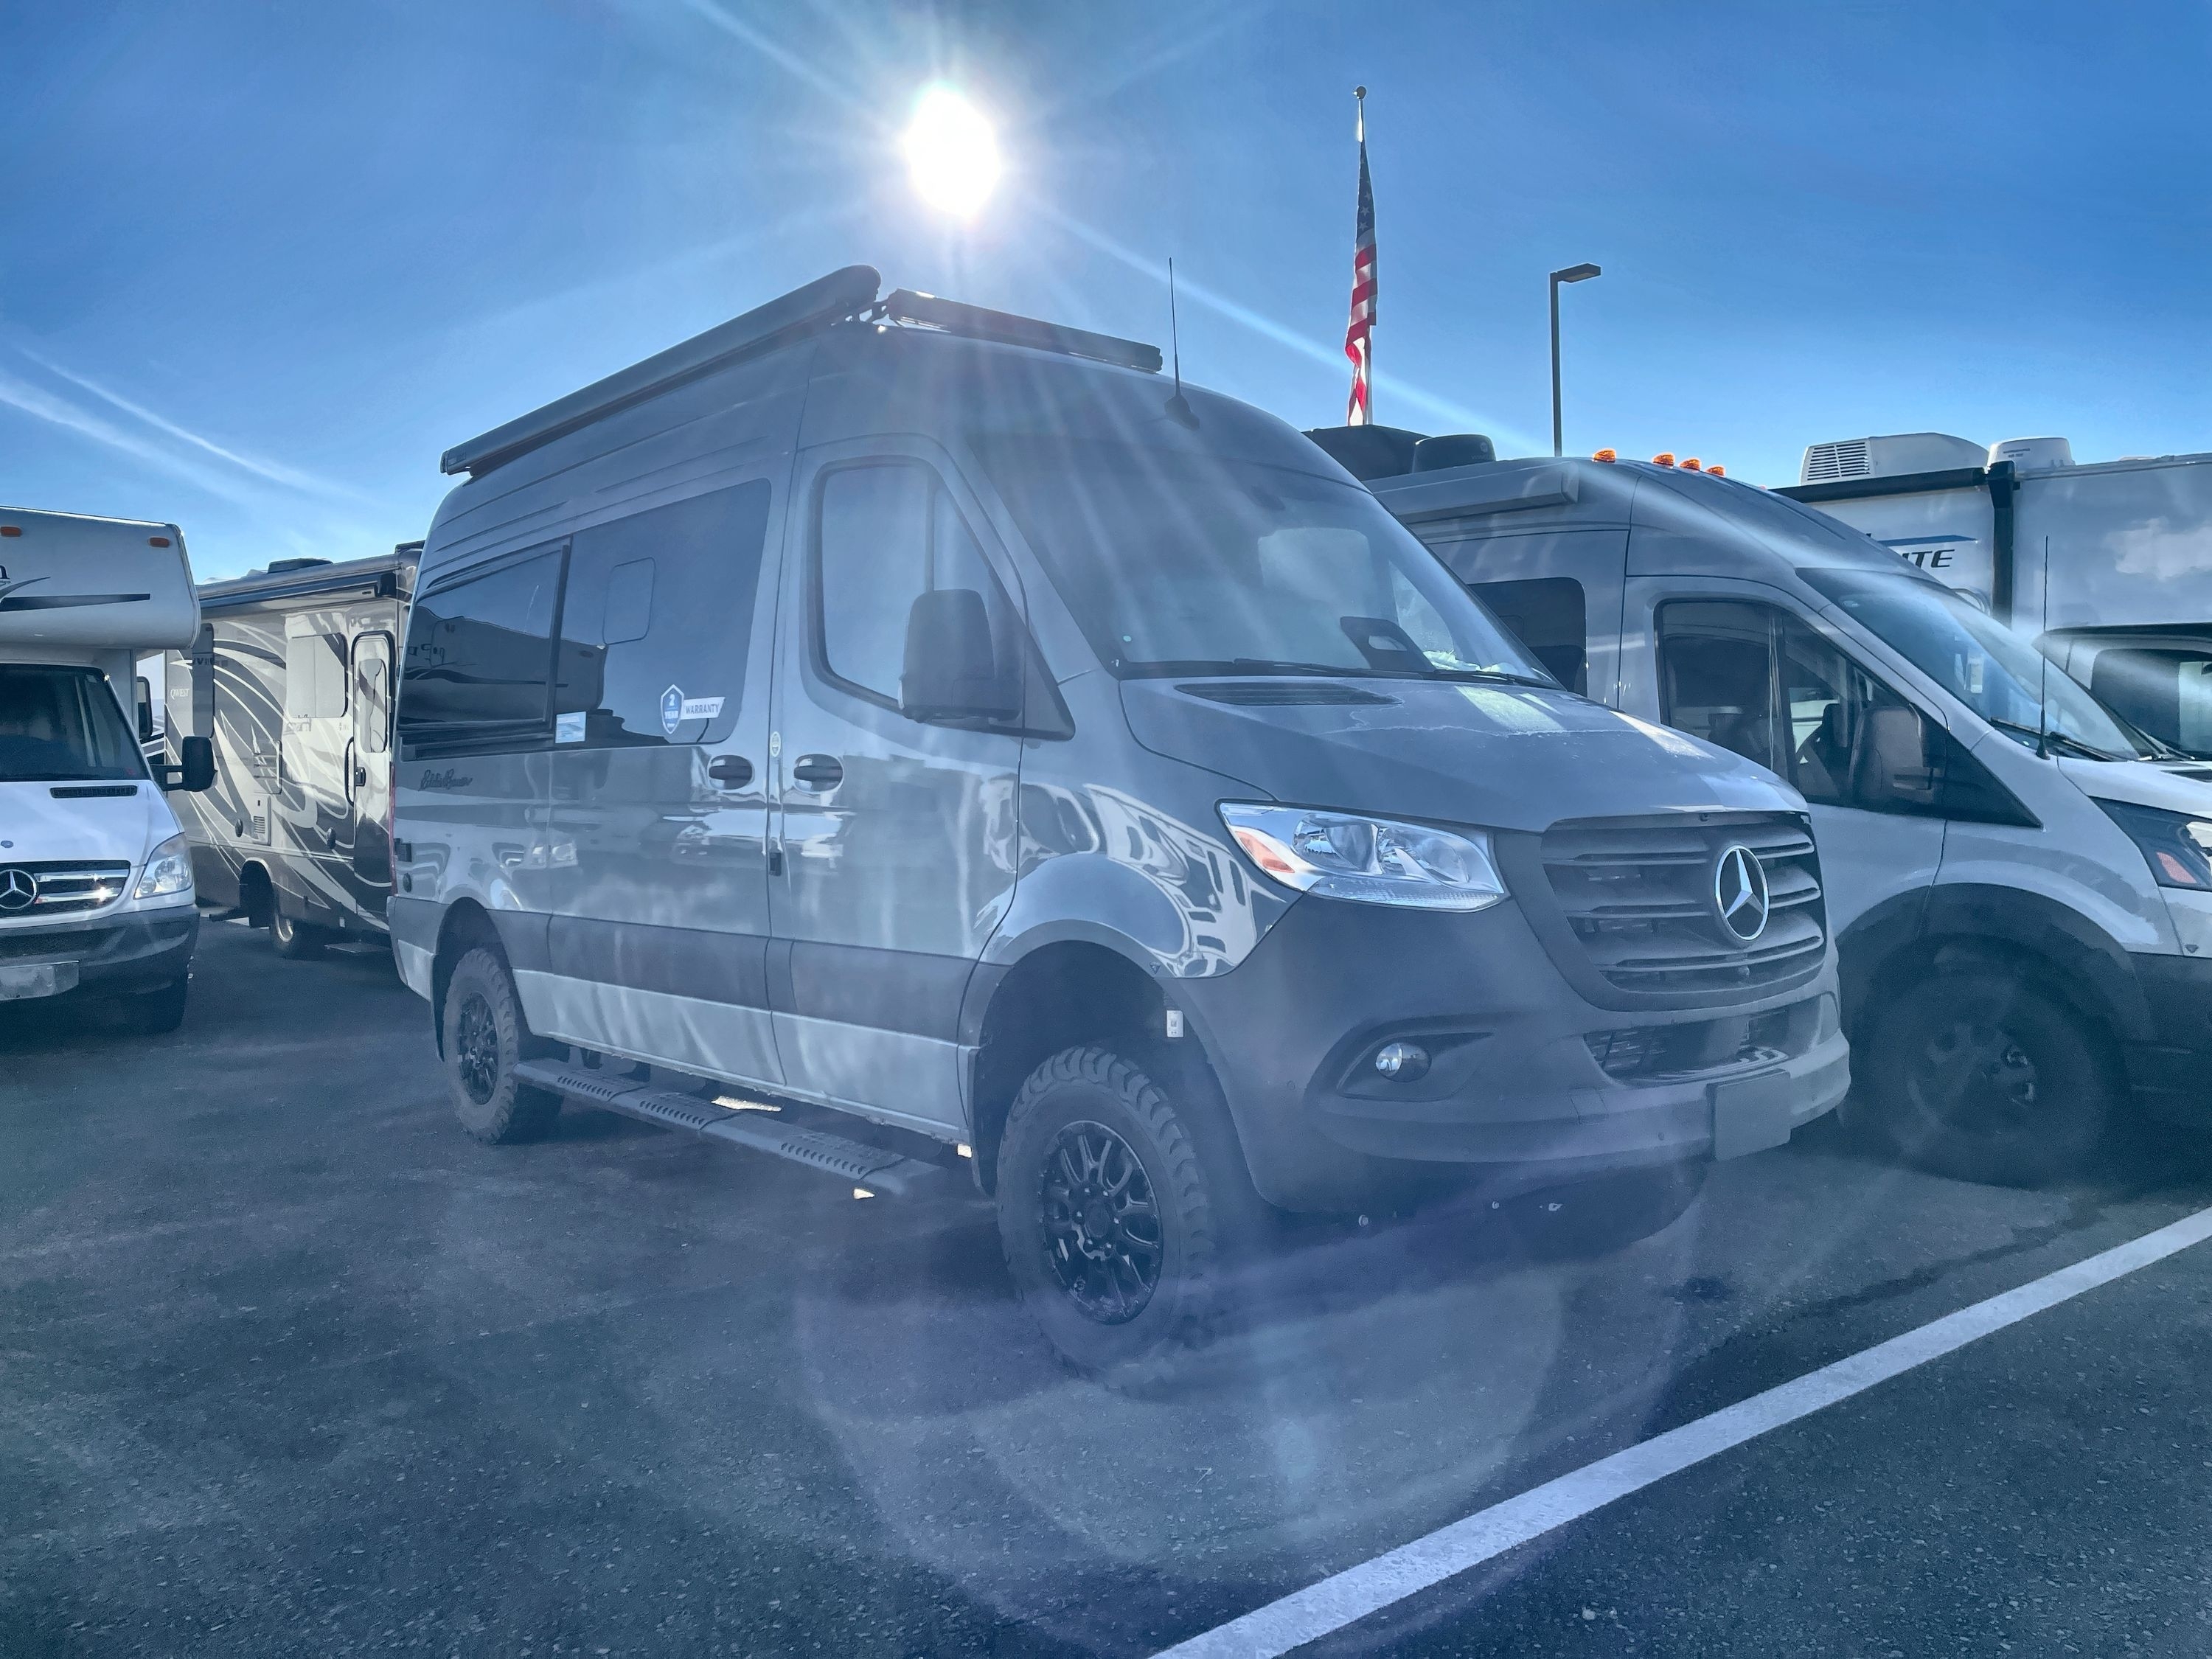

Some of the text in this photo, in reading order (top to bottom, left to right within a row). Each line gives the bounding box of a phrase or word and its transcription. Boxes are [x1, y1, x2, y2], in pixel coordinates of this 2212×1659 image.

[170, 689, 189, 700] QWEST
[669, 694, 675, 706] 2
[686, 703, 720, 714] WARRANTY
